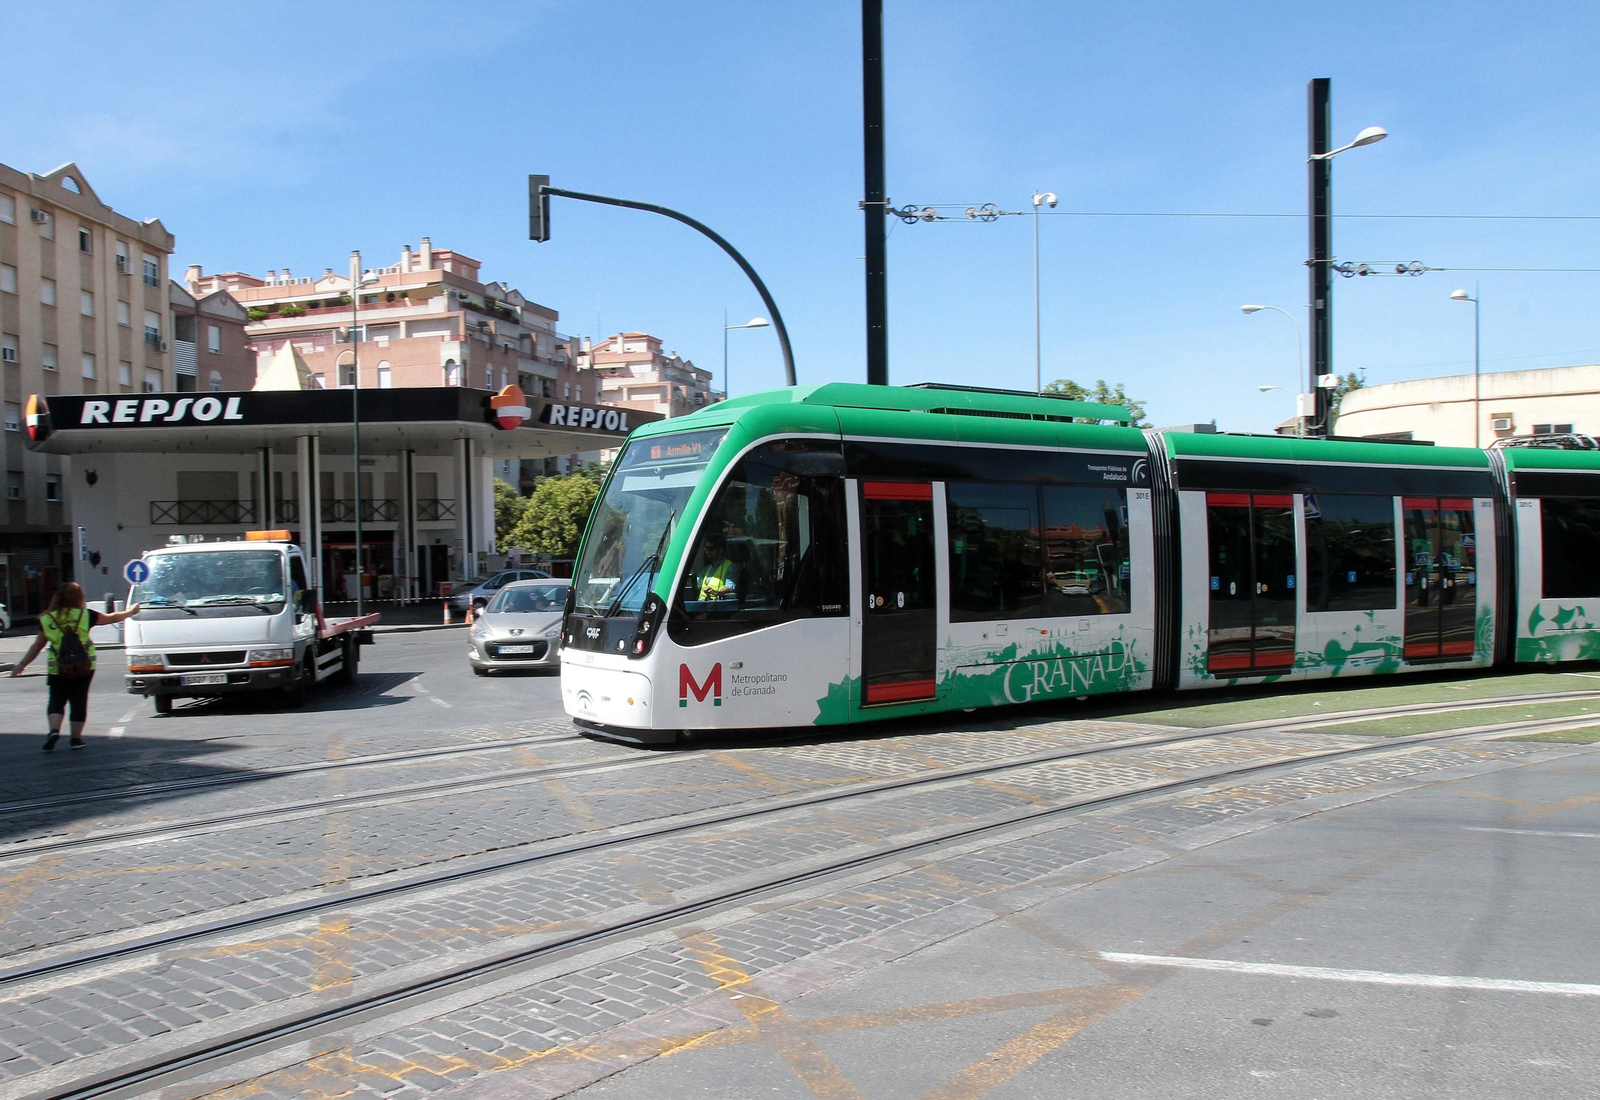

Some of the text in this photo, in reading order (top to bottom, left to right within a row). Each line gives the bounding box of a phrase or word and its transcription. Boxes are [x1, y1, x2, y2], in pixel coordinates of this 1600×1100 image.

[80, 397, 243, 424] REPSOL
[549, 403, 629, 432] REPSOL
[666, 444, 691, 457] Armilla
[731, 672, 788, 685] Metropolitano
[1003, 639, 1138, 704] GRANADA
[731, 685, 776, 697] de Granada
